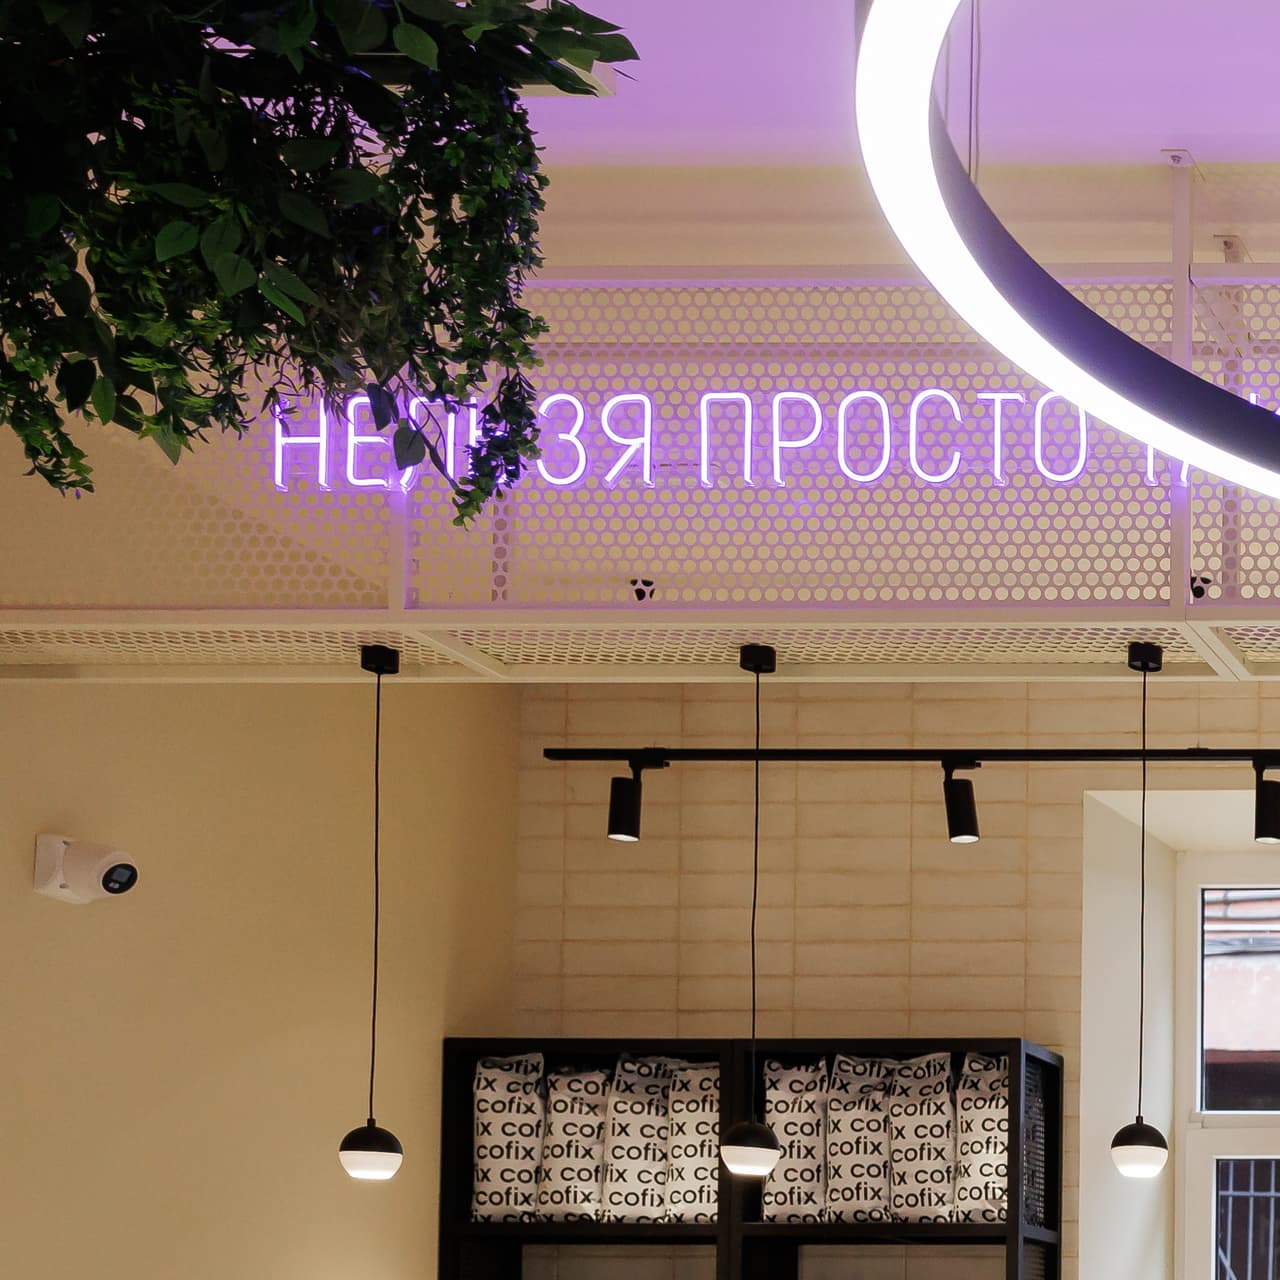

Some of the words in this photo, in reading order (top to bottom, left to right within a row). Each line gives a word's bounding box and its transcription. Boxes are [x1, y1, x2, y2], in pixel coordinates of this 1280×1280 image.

[702, 390, 1088, 487] ПРОСТО
[899, 1058, 946, 1079] cofix
[477, 1096, 537, 1114] cofix
[765, 1097, 816, 1114] cofix
[829, 1097, 882, 1112] cofix
[890, 1098, 946, 1117] cofix
[477, 1140, 535, 1160] cofix
[829, 1136, 883, 1156] cofix
[892, 1143, 946, 1163] cofix
[475, 1187, 533, 1206] cofix
[539, 1185, 593, 1204] cofix
[764, 1187, 817, 1205] cofix
[830, 1182, 882, 1201] cofix
[893, 1187, 947, 1208] cofix
